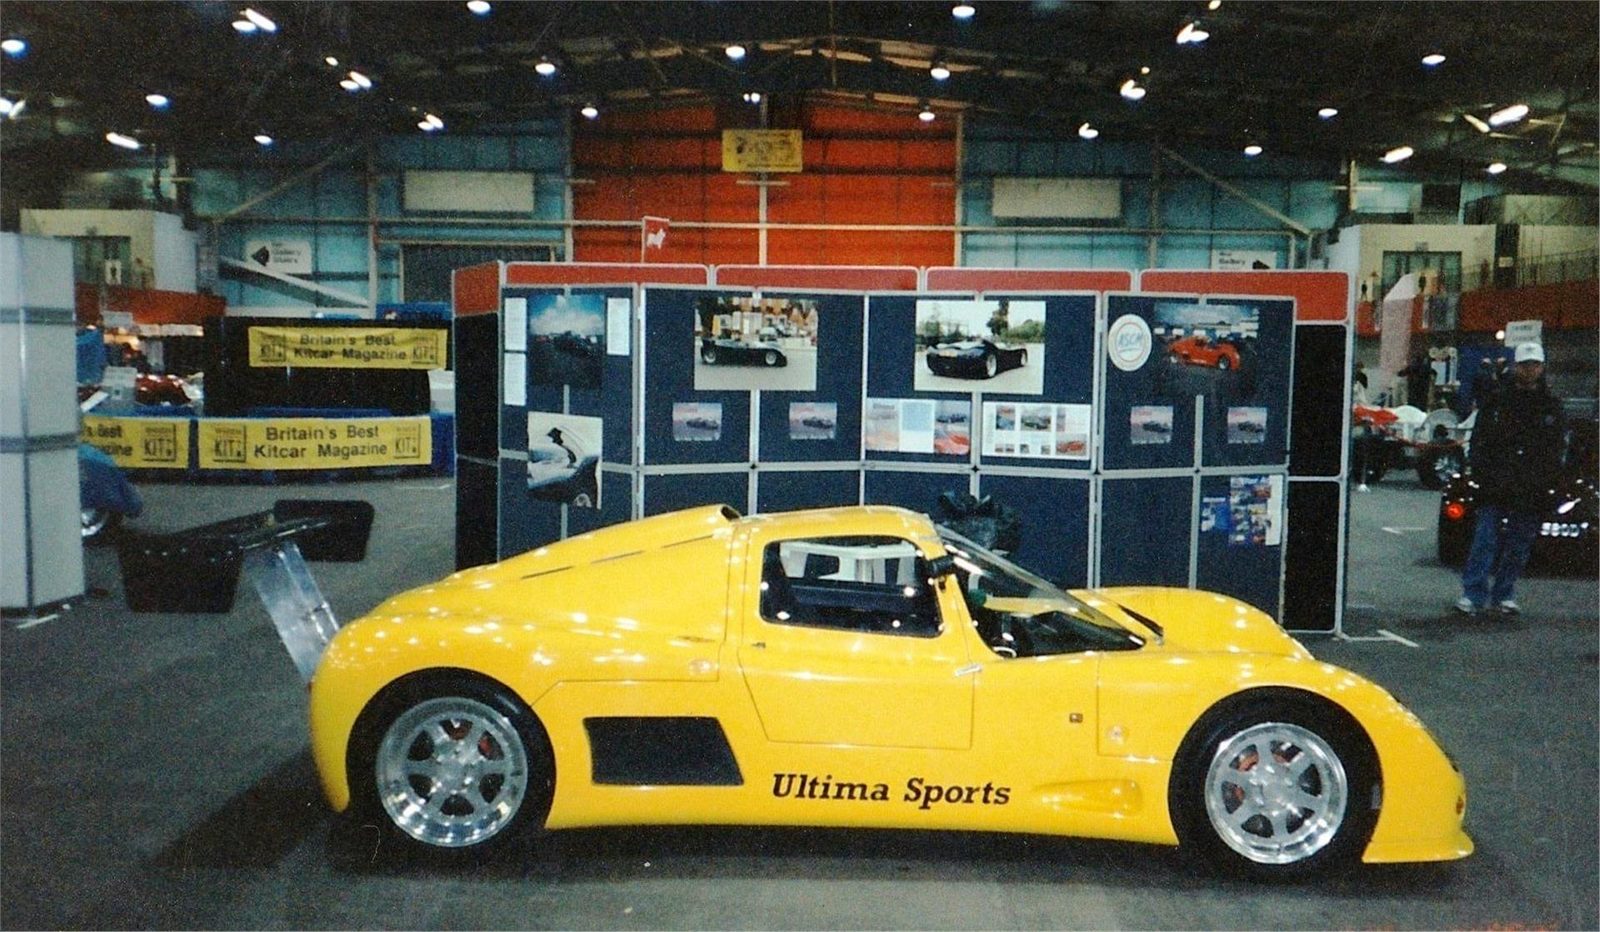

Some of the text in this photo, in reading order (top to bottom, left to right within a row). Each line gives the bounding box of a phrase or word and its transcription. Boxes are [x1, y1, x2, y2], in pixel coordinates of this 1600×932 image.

[365, 334, 395, 346] Best
[342, 348, 407, 362] Magazine
[266, 426, 338, 441] Britain's
[346, 425, 379, 439] Best
[254, 443, 388, 460] Kitcar Magazine
[772, 773, 1011, 810] Ultima Sports
